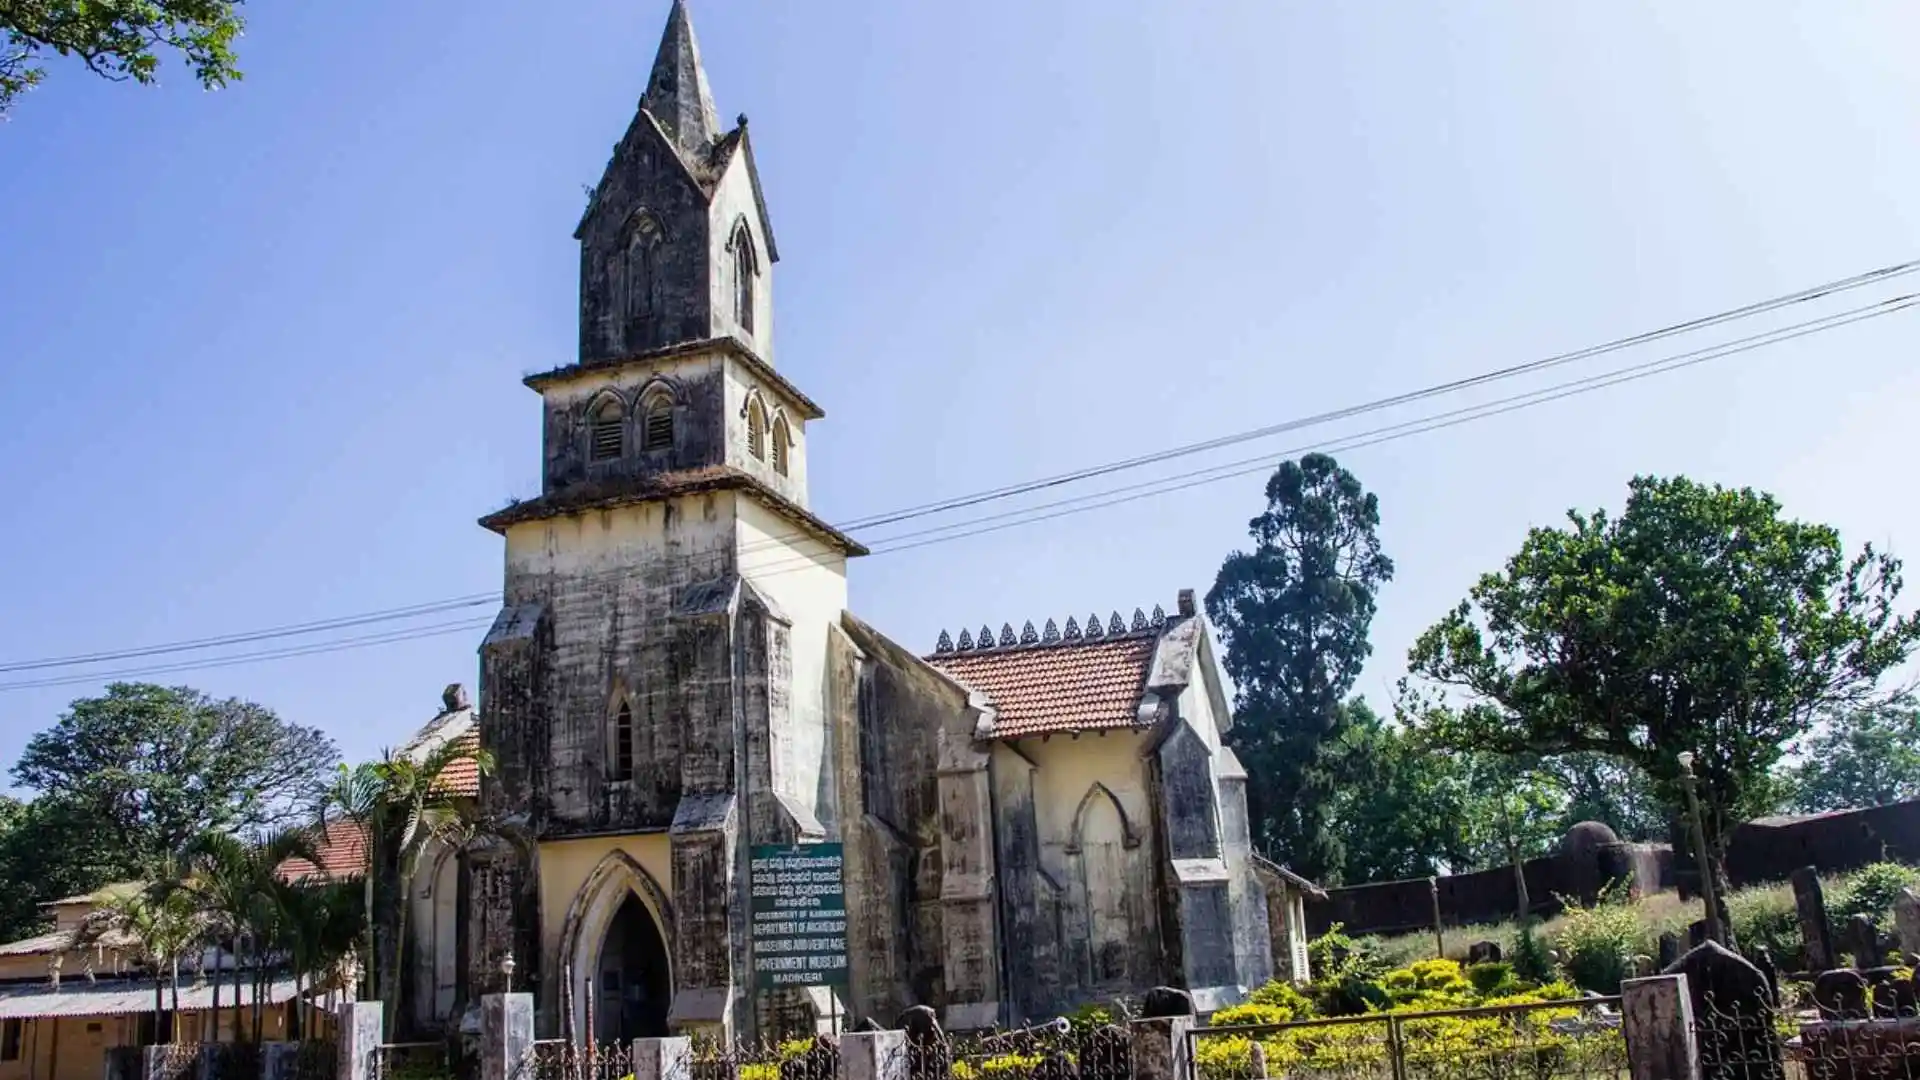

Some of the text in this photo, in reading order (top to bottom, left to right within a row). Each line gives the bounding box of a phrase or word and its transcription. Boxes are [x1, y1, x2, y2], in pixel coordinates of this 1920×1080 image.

[799, 910, 808, 918] OF
[753, 922, 797, 935] DEPARTMENT
[798, 922, 806, 933] OF
[754, 938, 846, 952] MUSEUMS AND HERITAGE
[755, 955, 847, 971] GOVERNMENT MUSEUM
[772, 973, 823, 984] MADIKERI
